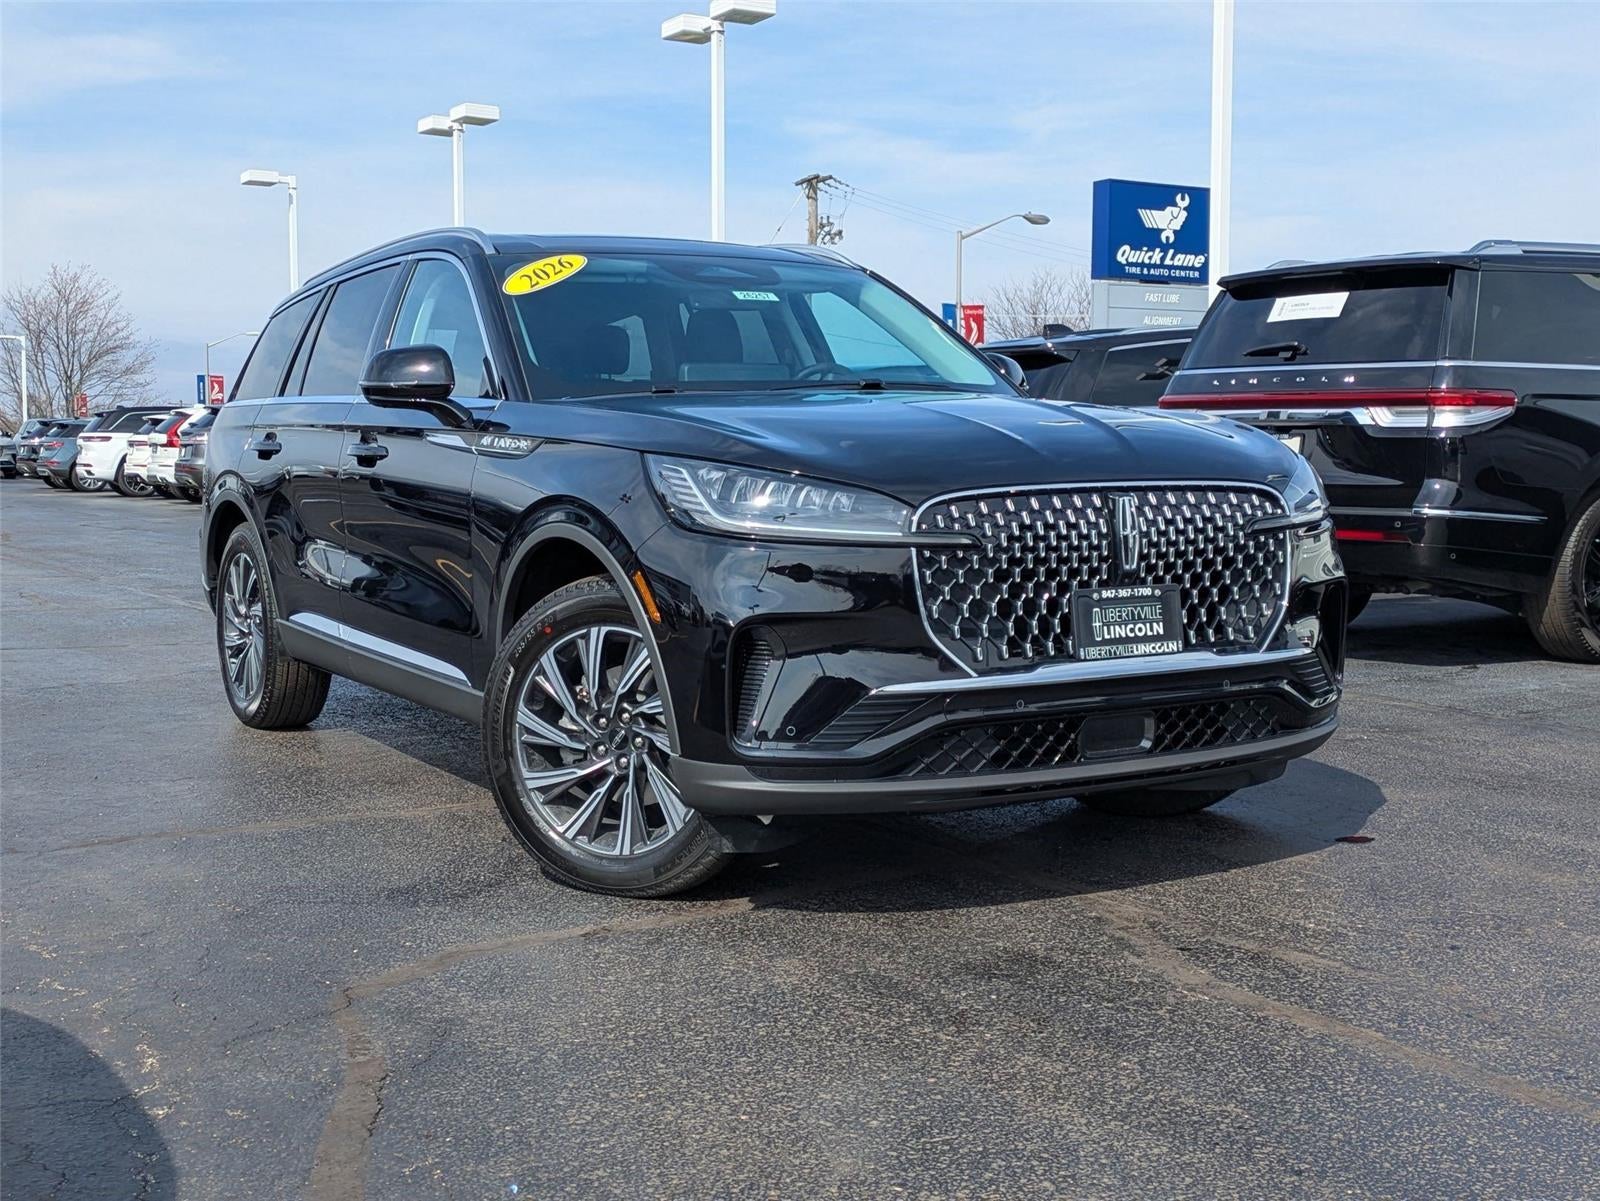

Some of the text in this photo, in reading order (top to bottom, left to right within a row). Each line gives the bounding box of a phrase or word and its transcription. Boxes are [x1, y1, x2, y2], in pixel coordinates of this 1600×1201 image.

[1116, 245, 1205, 268] Quick Lane
[519, 257, 574, 288] 2026
[1125, 266, 1200, 278] TIRE & AUTO CENTER
[1144, 293, 1181, 303] FAST LUBE
[1143, 316, 1182, 326] ALIGNMENT
[1101, 588, 1152, 598] 847-367-1700
[1102, 605, 1163, 622] LIBERTYVILLE
[1103, 622, 1164, 639] LINCOLN
